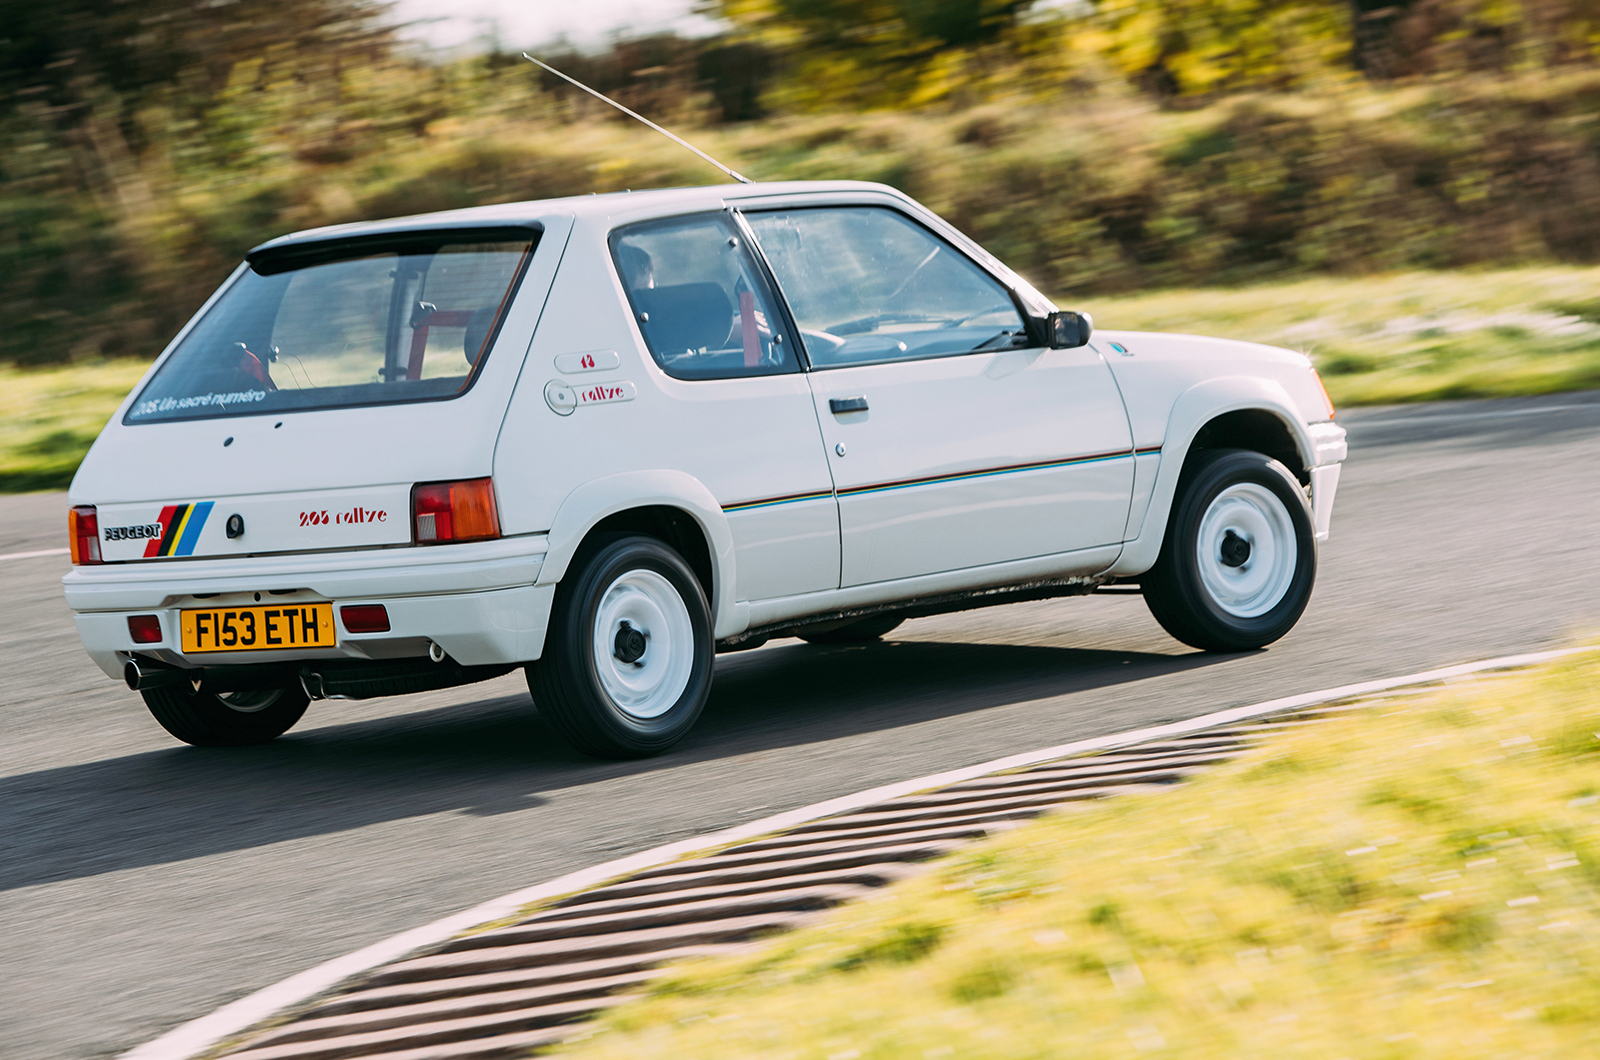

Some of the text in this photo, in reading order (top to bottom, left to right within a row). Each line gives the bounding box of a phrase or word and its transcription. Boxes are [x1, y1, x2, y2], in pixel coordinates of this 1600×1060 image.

[210, 388, 266, 406] numéro
[582, 386, 624, 402] rallye
[299, 507, 387, 527] 205 rallye
[103, 522, 163, 541] PEUGEOT
[196, 608, 319, 648] F153 ETH
